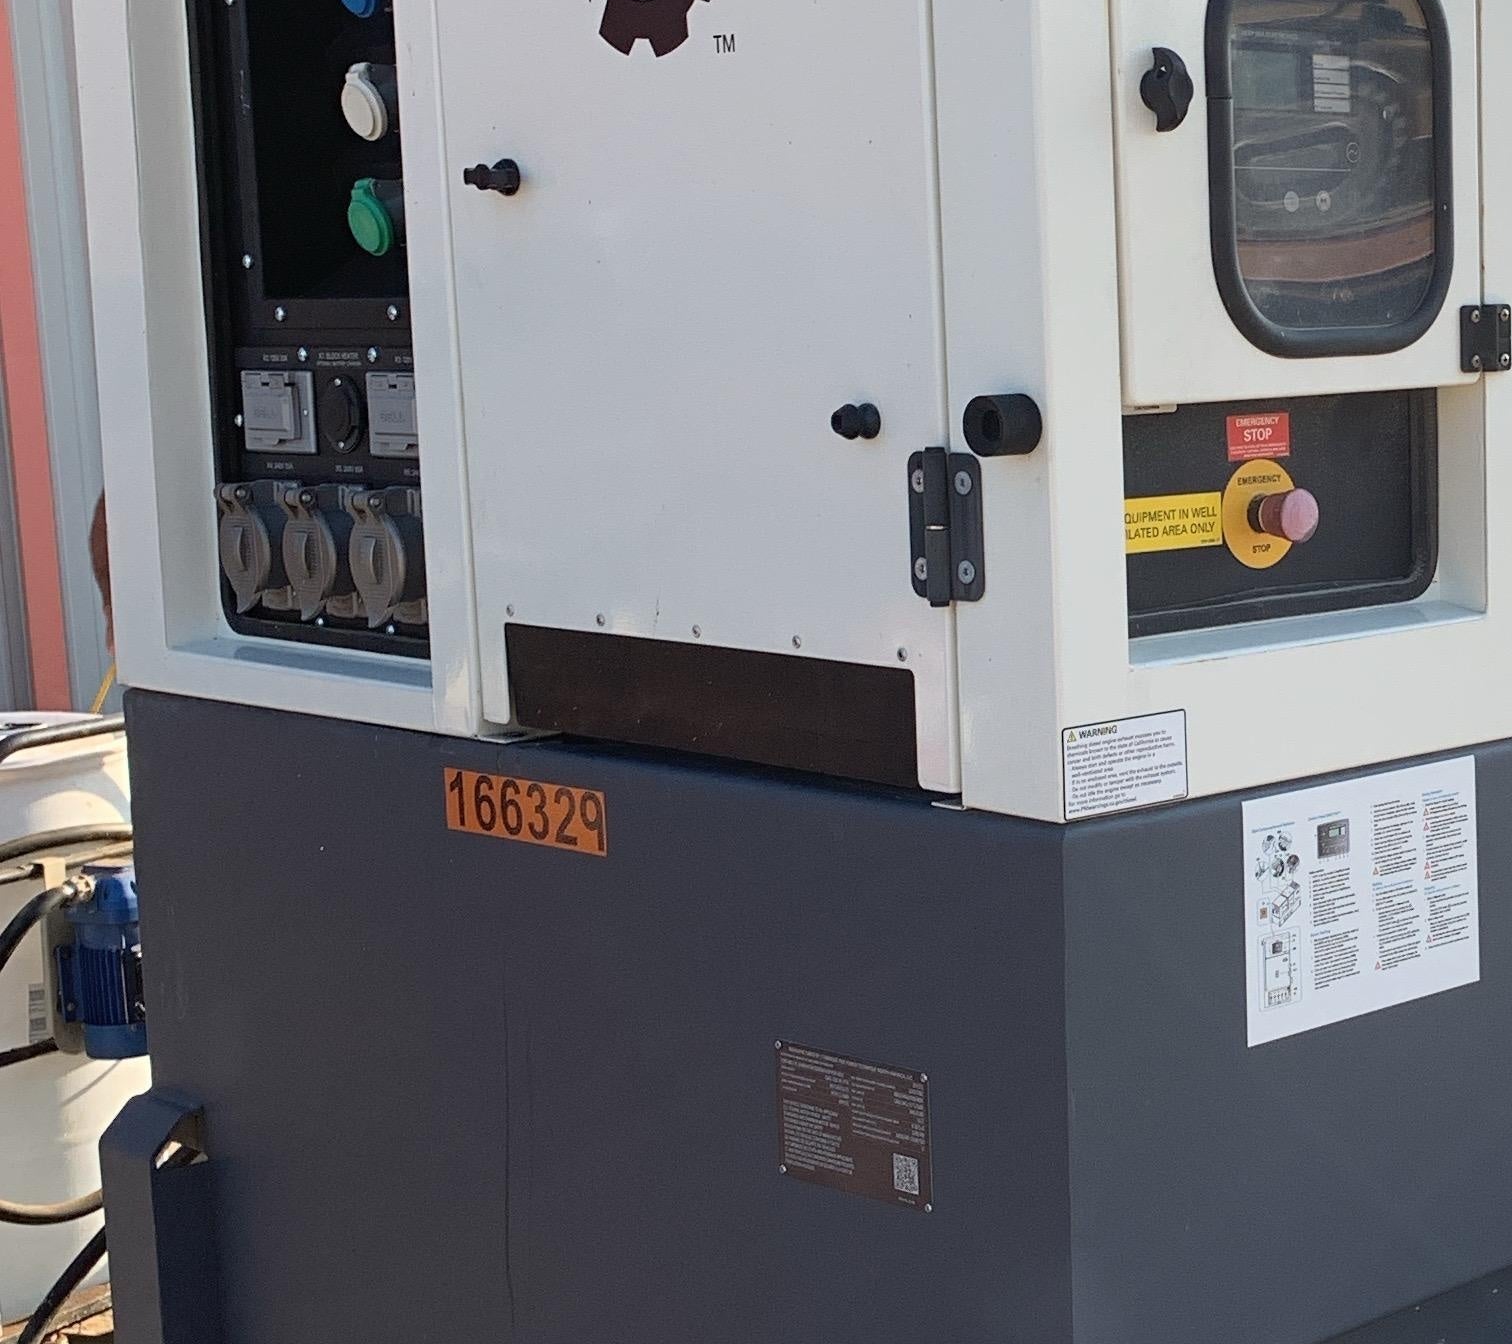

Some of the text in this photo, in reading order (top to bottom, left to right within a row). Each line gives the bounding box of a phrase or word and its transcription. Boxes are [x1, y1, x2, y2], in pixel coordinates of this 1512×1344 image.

[1235, 416, 1280, 427] EMERGENCY
[1243, 427, 1273, 442] STOP
[1237, 473, 1282, 486] EMERGENCY
[1124, 504, 1217, 524] QUIPMENT IN WELL
[1161, 522, 1188, 536] AREA
[1191, 521, 1216, 535] ONLY
[1252, 543, 1271, 554] STOP
[1079, 725, 1118, 739] WARNING
[450, 771, 605, 852] 166329
